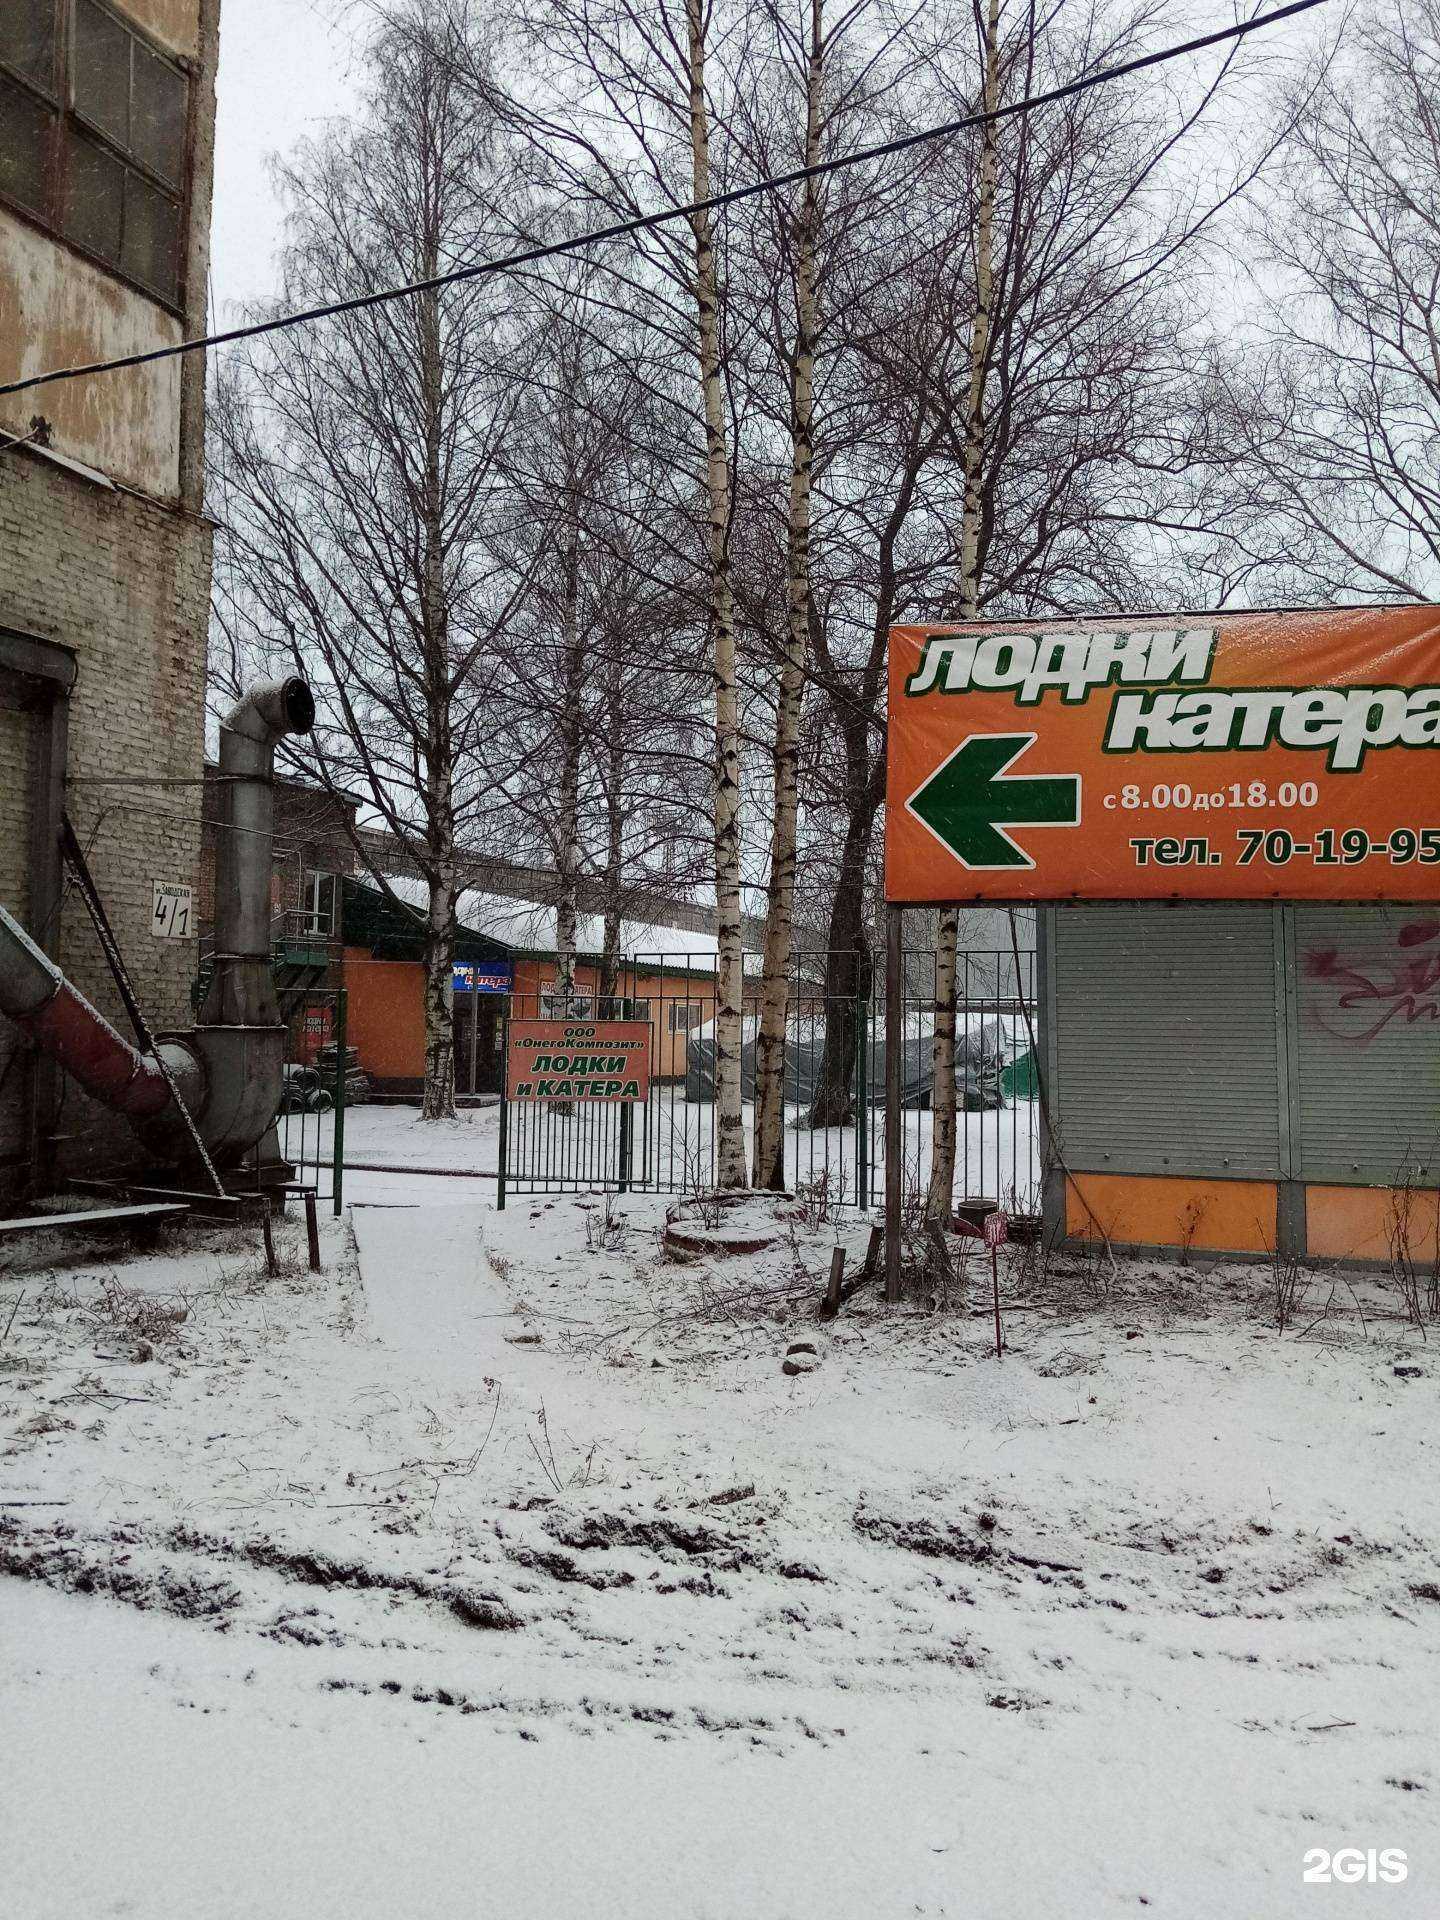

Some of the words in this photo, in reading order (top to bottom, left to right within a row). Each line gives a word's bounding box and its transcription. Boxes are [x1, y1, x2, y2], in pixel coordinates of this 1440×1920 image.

[907, 629, 1218, 705] лодки
[1103, 686, 1440, 773] катера
[1129, 836, 1222, 866] тел.
[154, 895, 189, 937] 4/1
[514, 1037, 645, 1049] «ОнегоКомпозит»
[563, 1027, 596, 1038] ООО
[531, 1054, 627, 1077] ЛОДКИ
[536, 1079, 640, 1098] КАТЕРА
